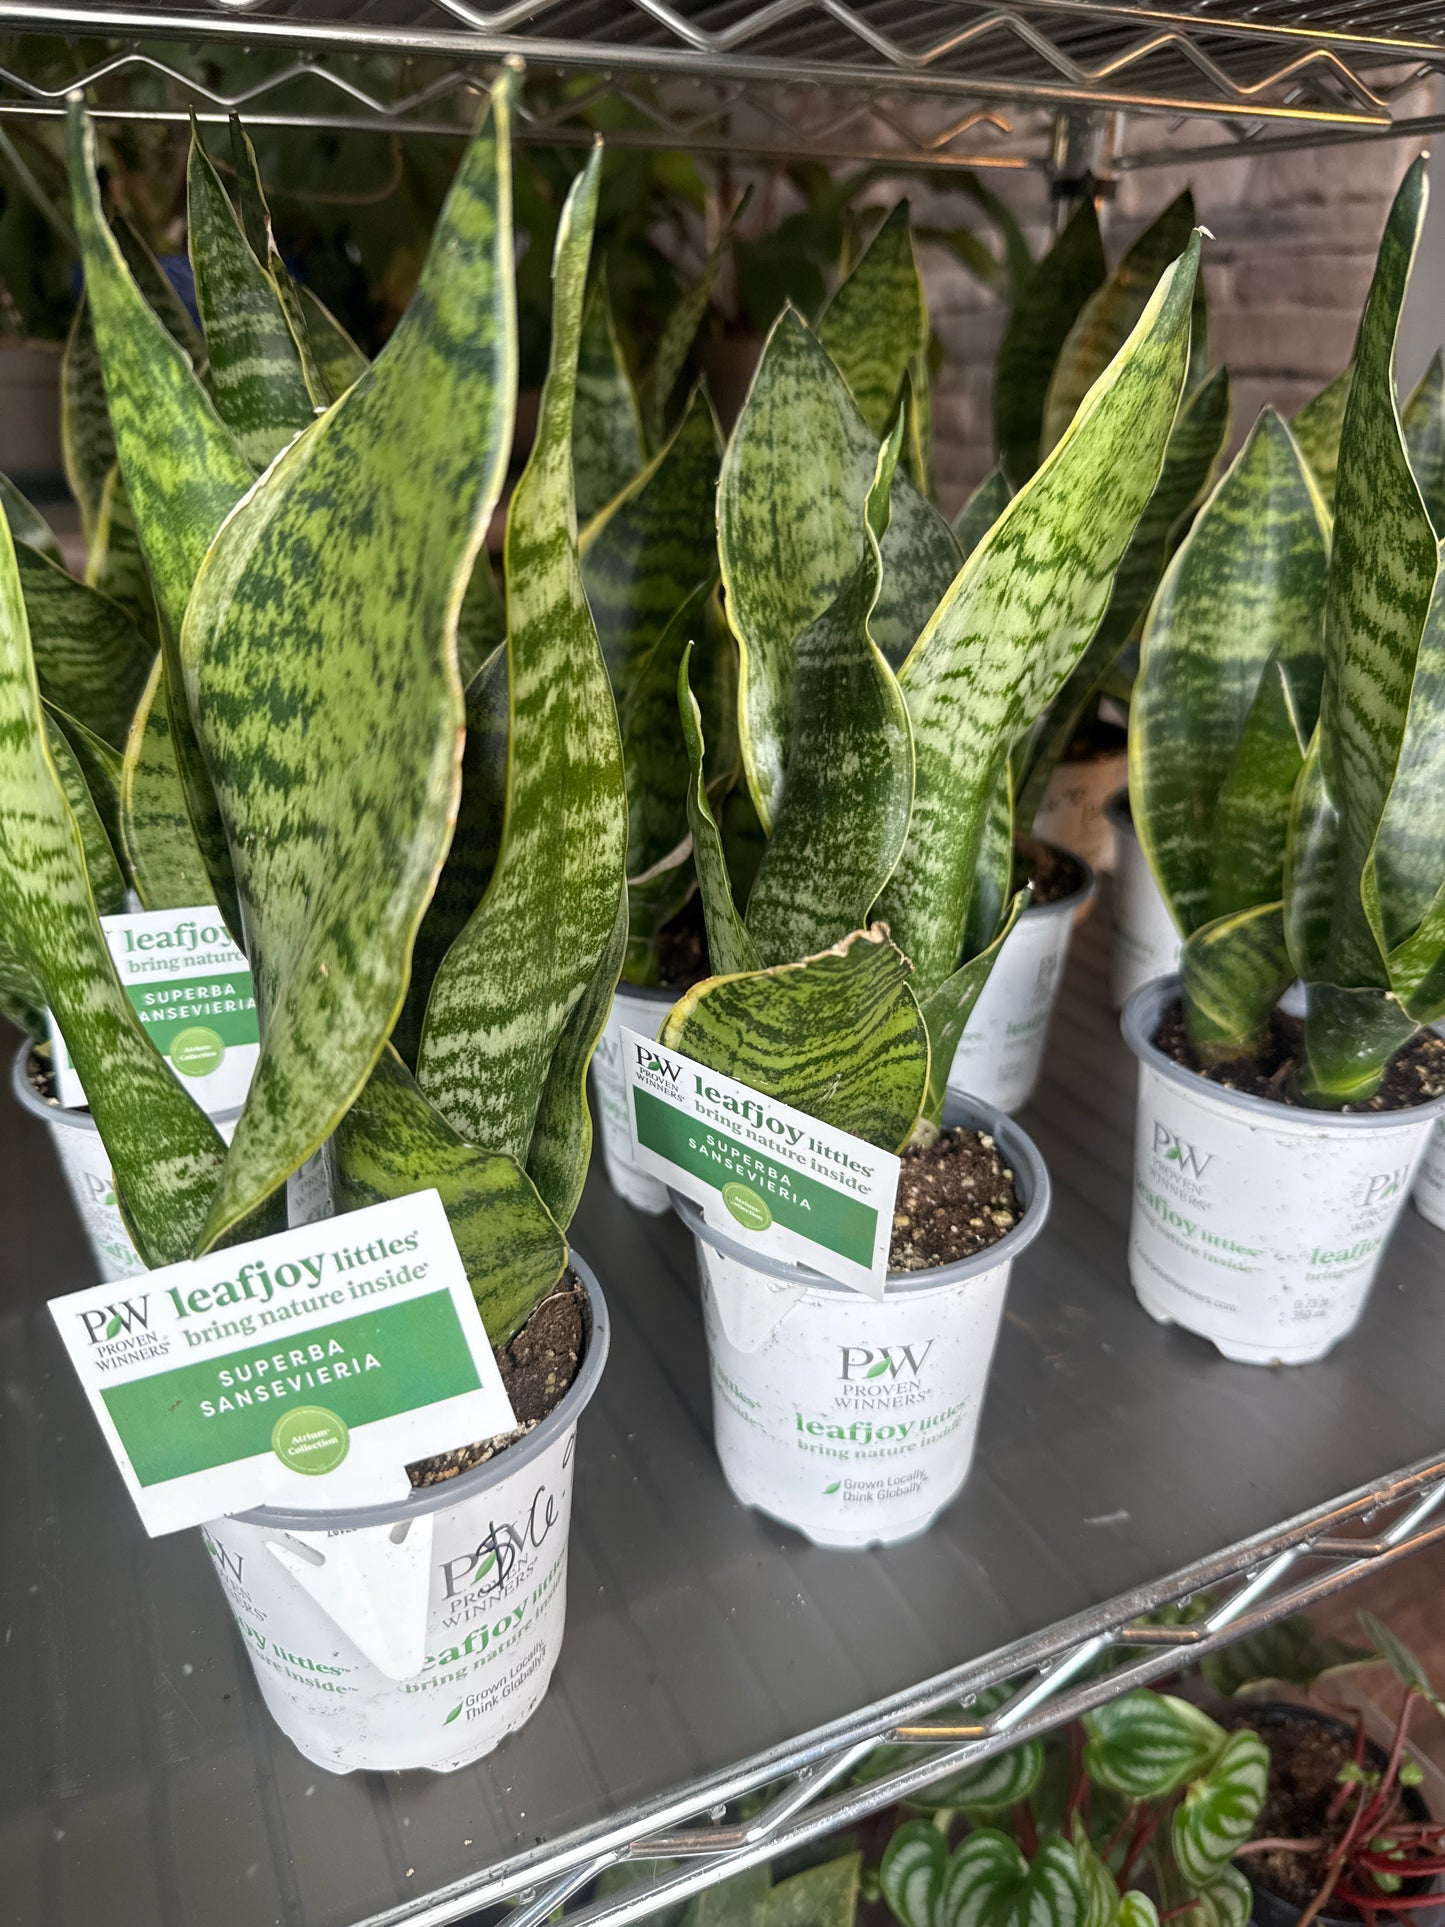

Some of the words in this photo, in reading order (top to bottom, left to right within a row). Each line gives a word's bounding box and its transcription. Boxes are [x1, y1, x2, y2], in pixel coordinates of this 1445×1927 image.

[124, 921, 233, 951] leafjoy
[128, 956, 181, 974] bring
[144, 983, 236, 1006] SUPERBA
[139, 998, 256, 1023] ANSEVIERIA
[636, 1072, 683, 1102] WINNERS
[639, 1067, 679, 1092] PROVEN
[694, 1074, 805, 1146] leafjoy
[809, 1136, 873, 1177] littles
[695, 1100, 742, 1136] bring
[746, 1128, 807, 1165] nature
[810, 1158, 869, 1195] inside
[706, 1134, 792, 1187] SUPERBA
[688, 1138, 811, 1211] SANSEVIERIA
[166, 1252, 326, 1320] leafjoy
[332, 1233, 418, 1273] littles
[182, 1314, 257, 1348] bring
[259, 1288, 345, 1327] nature
[348, 1263, 427, 1300] inside
[95, 1344, 169, 1373] WINNERS
[97, 1331, 158, 1358] PROVEN
[218, 1339, 345, 1388] SUPERBA
[200, 1353, 382, 1418] SANSEVIERIA
[834, 1390, 928, 1410] WINNERS
[843, 1379, 922, 1397] PROVEN
[795, 1411, 915, 1445] leafjoy
[919, 1400, 966, 1431] littles
[287, 1436, 339, 1456] Collection
[797, 1438, 850, 1460] bring
[855, 1442, 917, 1459] nature
[842, 1491, 874, 1503] Think
[843, 1477, 884, 1491] Grown
[442, 1564, 535, 1629] WINNERS
[422, 1597, 528, 1672] eafjoy
[271, 1643, 343, 1677] littles
[405, 1666, 468, 1695] bring
[473, 1618, 533, 1670] nature
[285, 1664, 348, 1694] inside
[465, 1676, 507, 1707] Grown
[465, 1695, 499, 1721] Think
